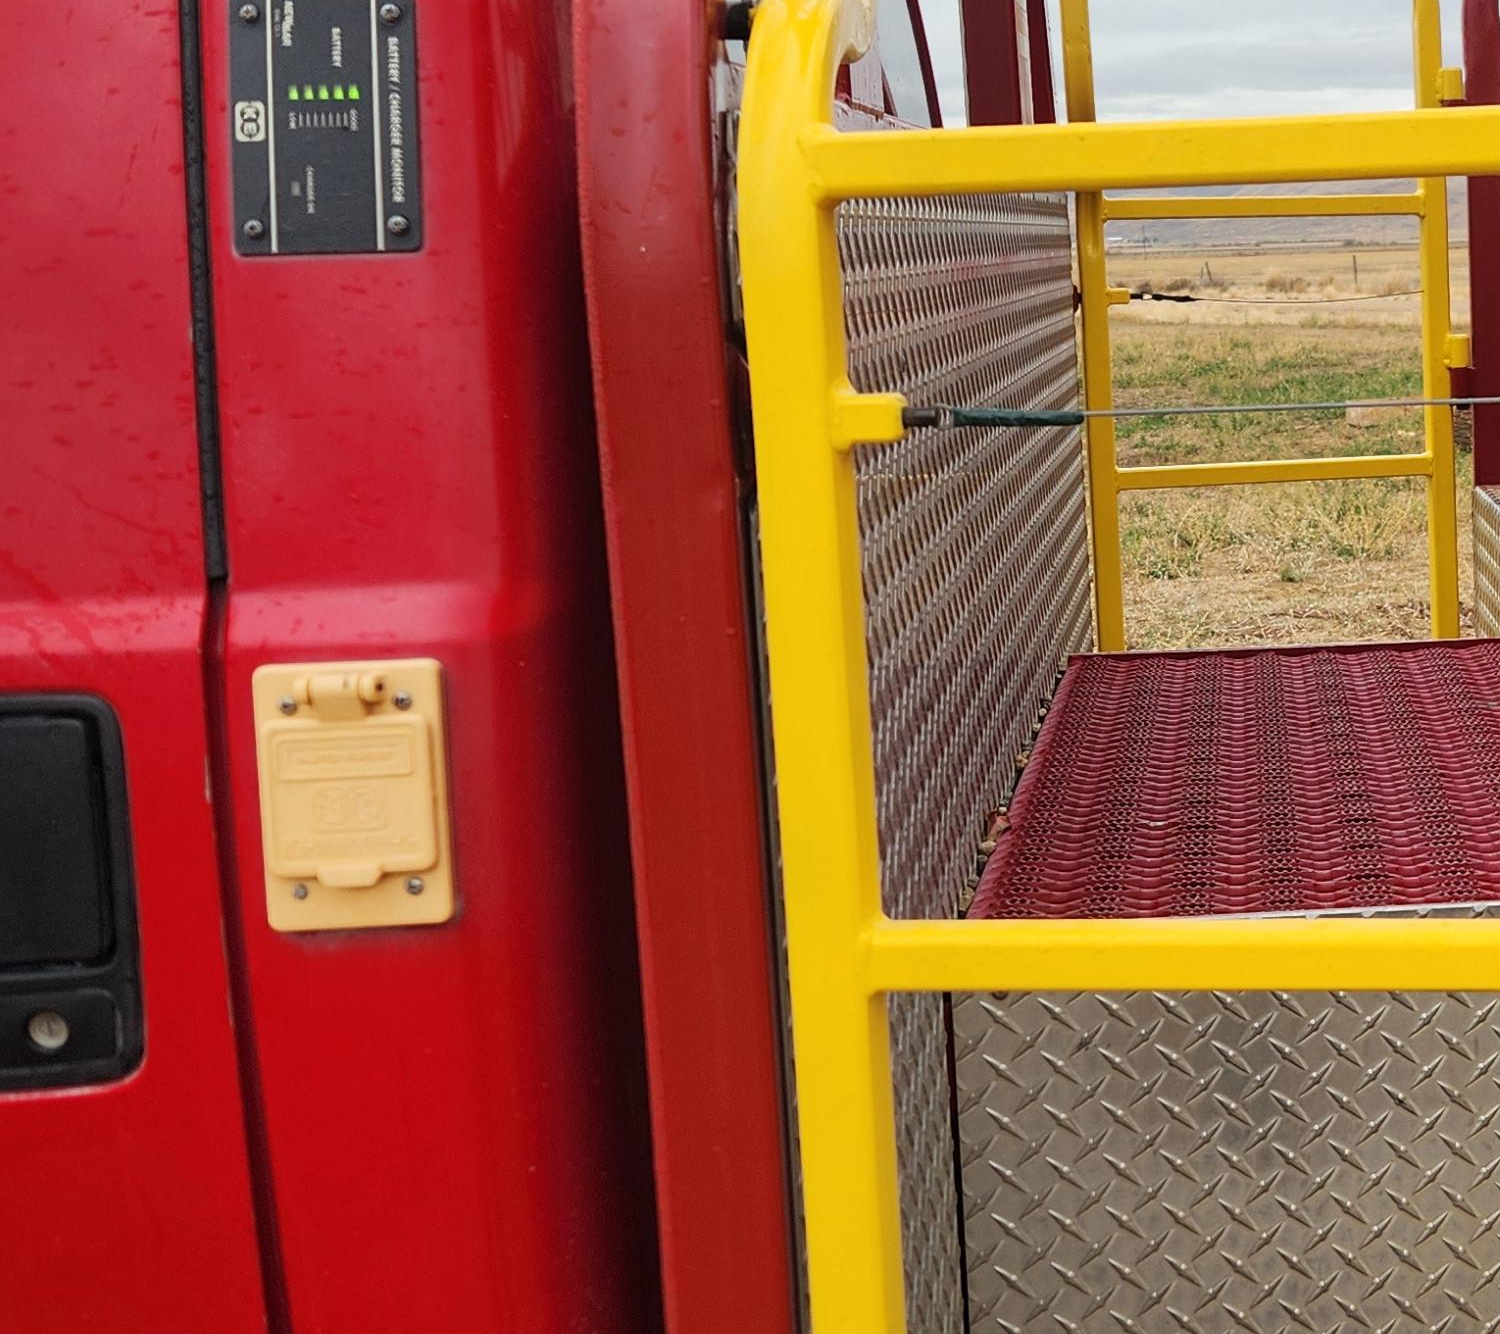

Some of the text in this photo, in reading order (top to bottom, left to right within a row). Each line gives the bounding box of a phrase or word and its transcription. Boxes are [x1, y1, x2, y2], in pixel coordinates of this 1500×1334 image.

[331, 27, 343, 68] BATTERY
[387, 37, 400, 82] BATTERY
[389, 92, 403, 146] CHARGER
[390, 147, 405, 203] MONITOR
